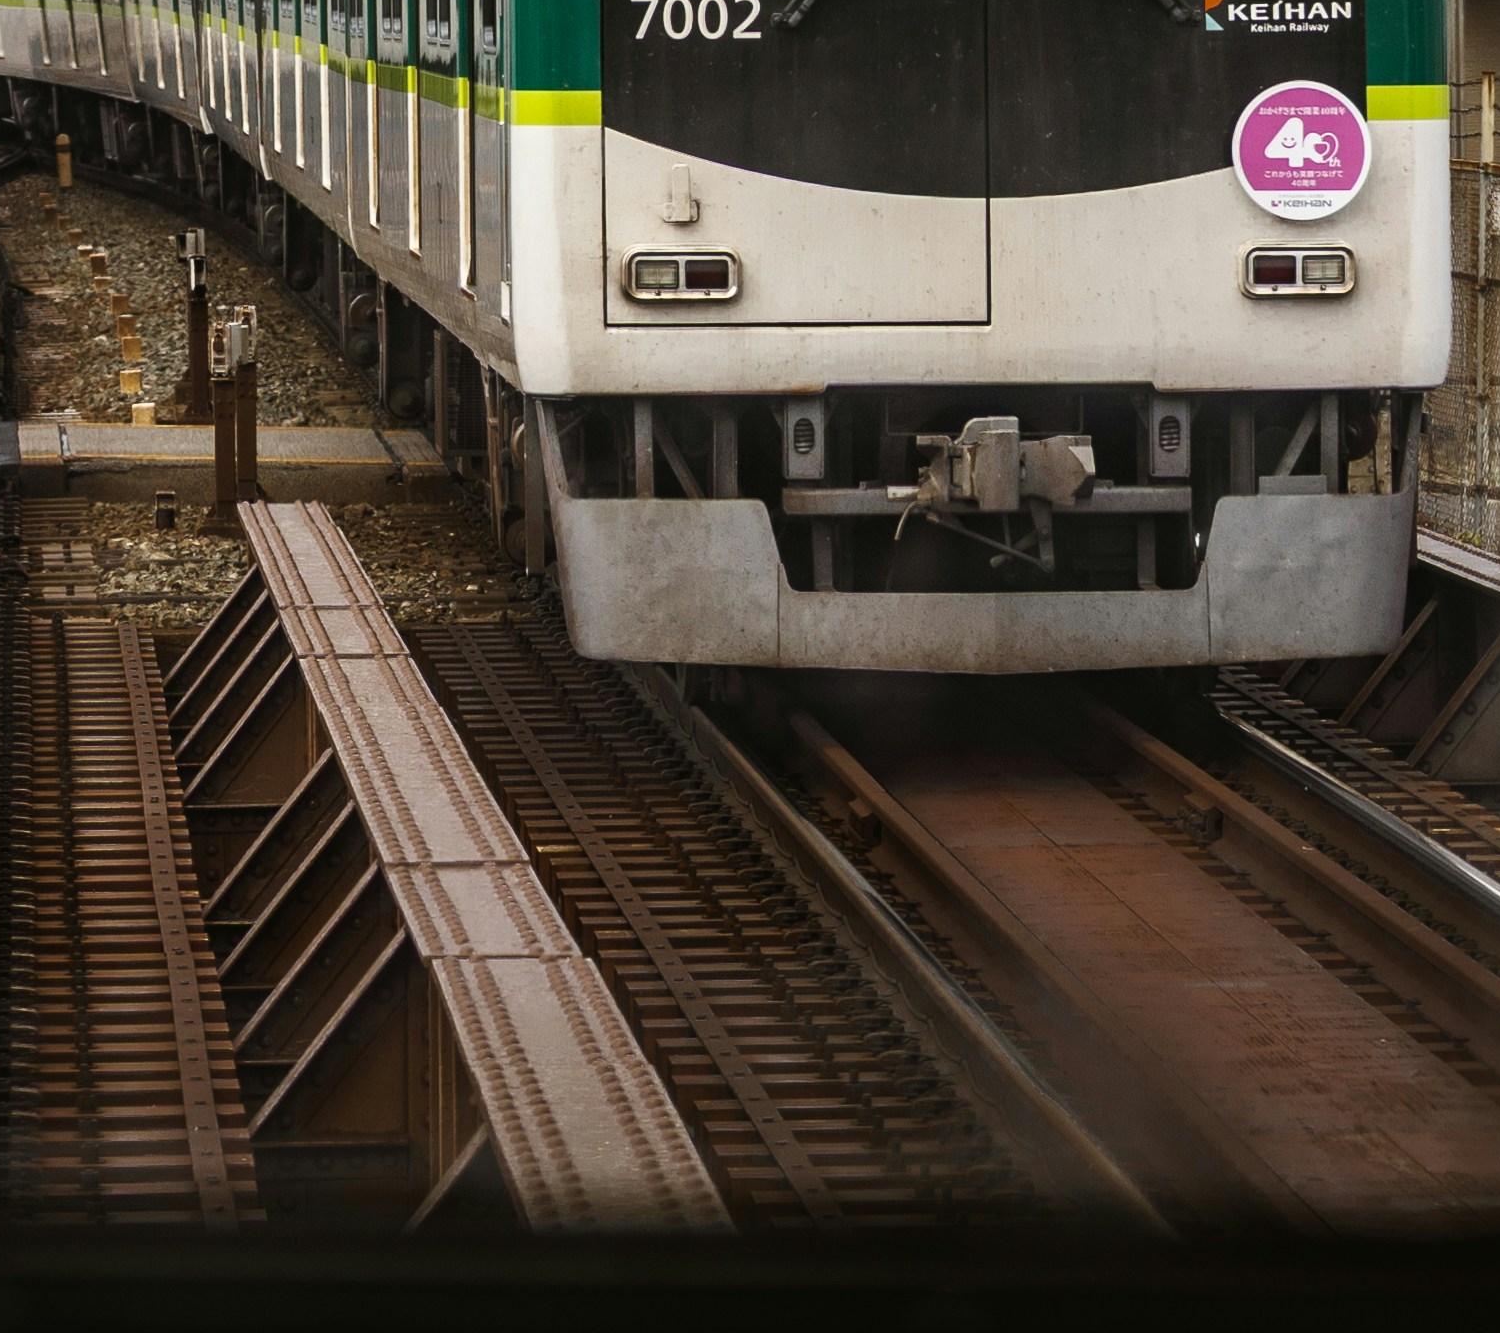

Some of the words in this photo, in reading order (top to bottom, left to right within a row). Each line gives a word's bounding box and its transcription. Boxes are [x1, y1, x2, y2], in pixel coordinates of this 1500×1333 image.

[1227, 0, 1352, 22] KEIHAN
[1250, 23, 1287, 33] Keihan
[1289, 22, 1330, 34] Railway
